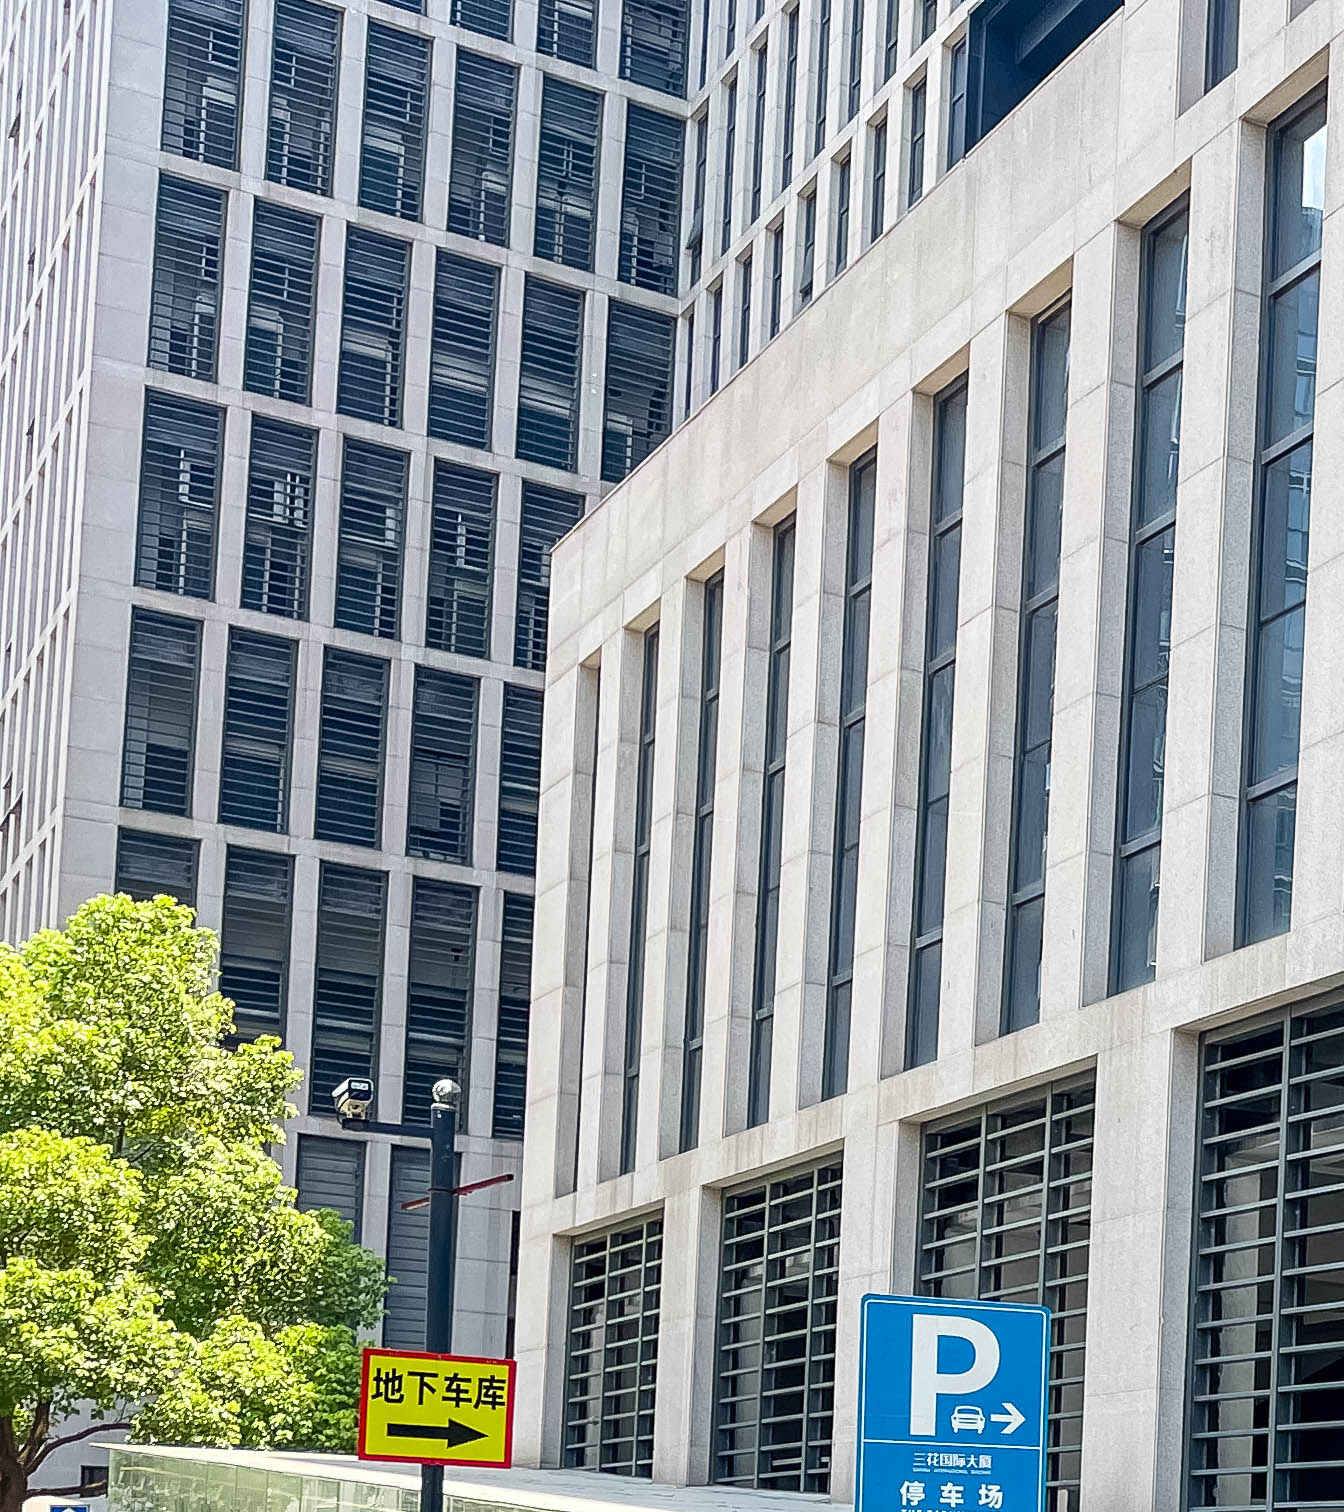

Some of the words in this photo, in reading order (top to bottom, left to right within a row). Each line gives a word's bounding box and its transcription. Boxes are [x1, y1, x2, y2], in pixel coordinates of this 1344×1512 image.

[371, 1367, 506, 1410] 地下车库
[910, 1313, 1000, 1437] P
[912, 1452, 992, 1469] 三花国际大厦
[900, 1480, 1004, 1509] 停车场
